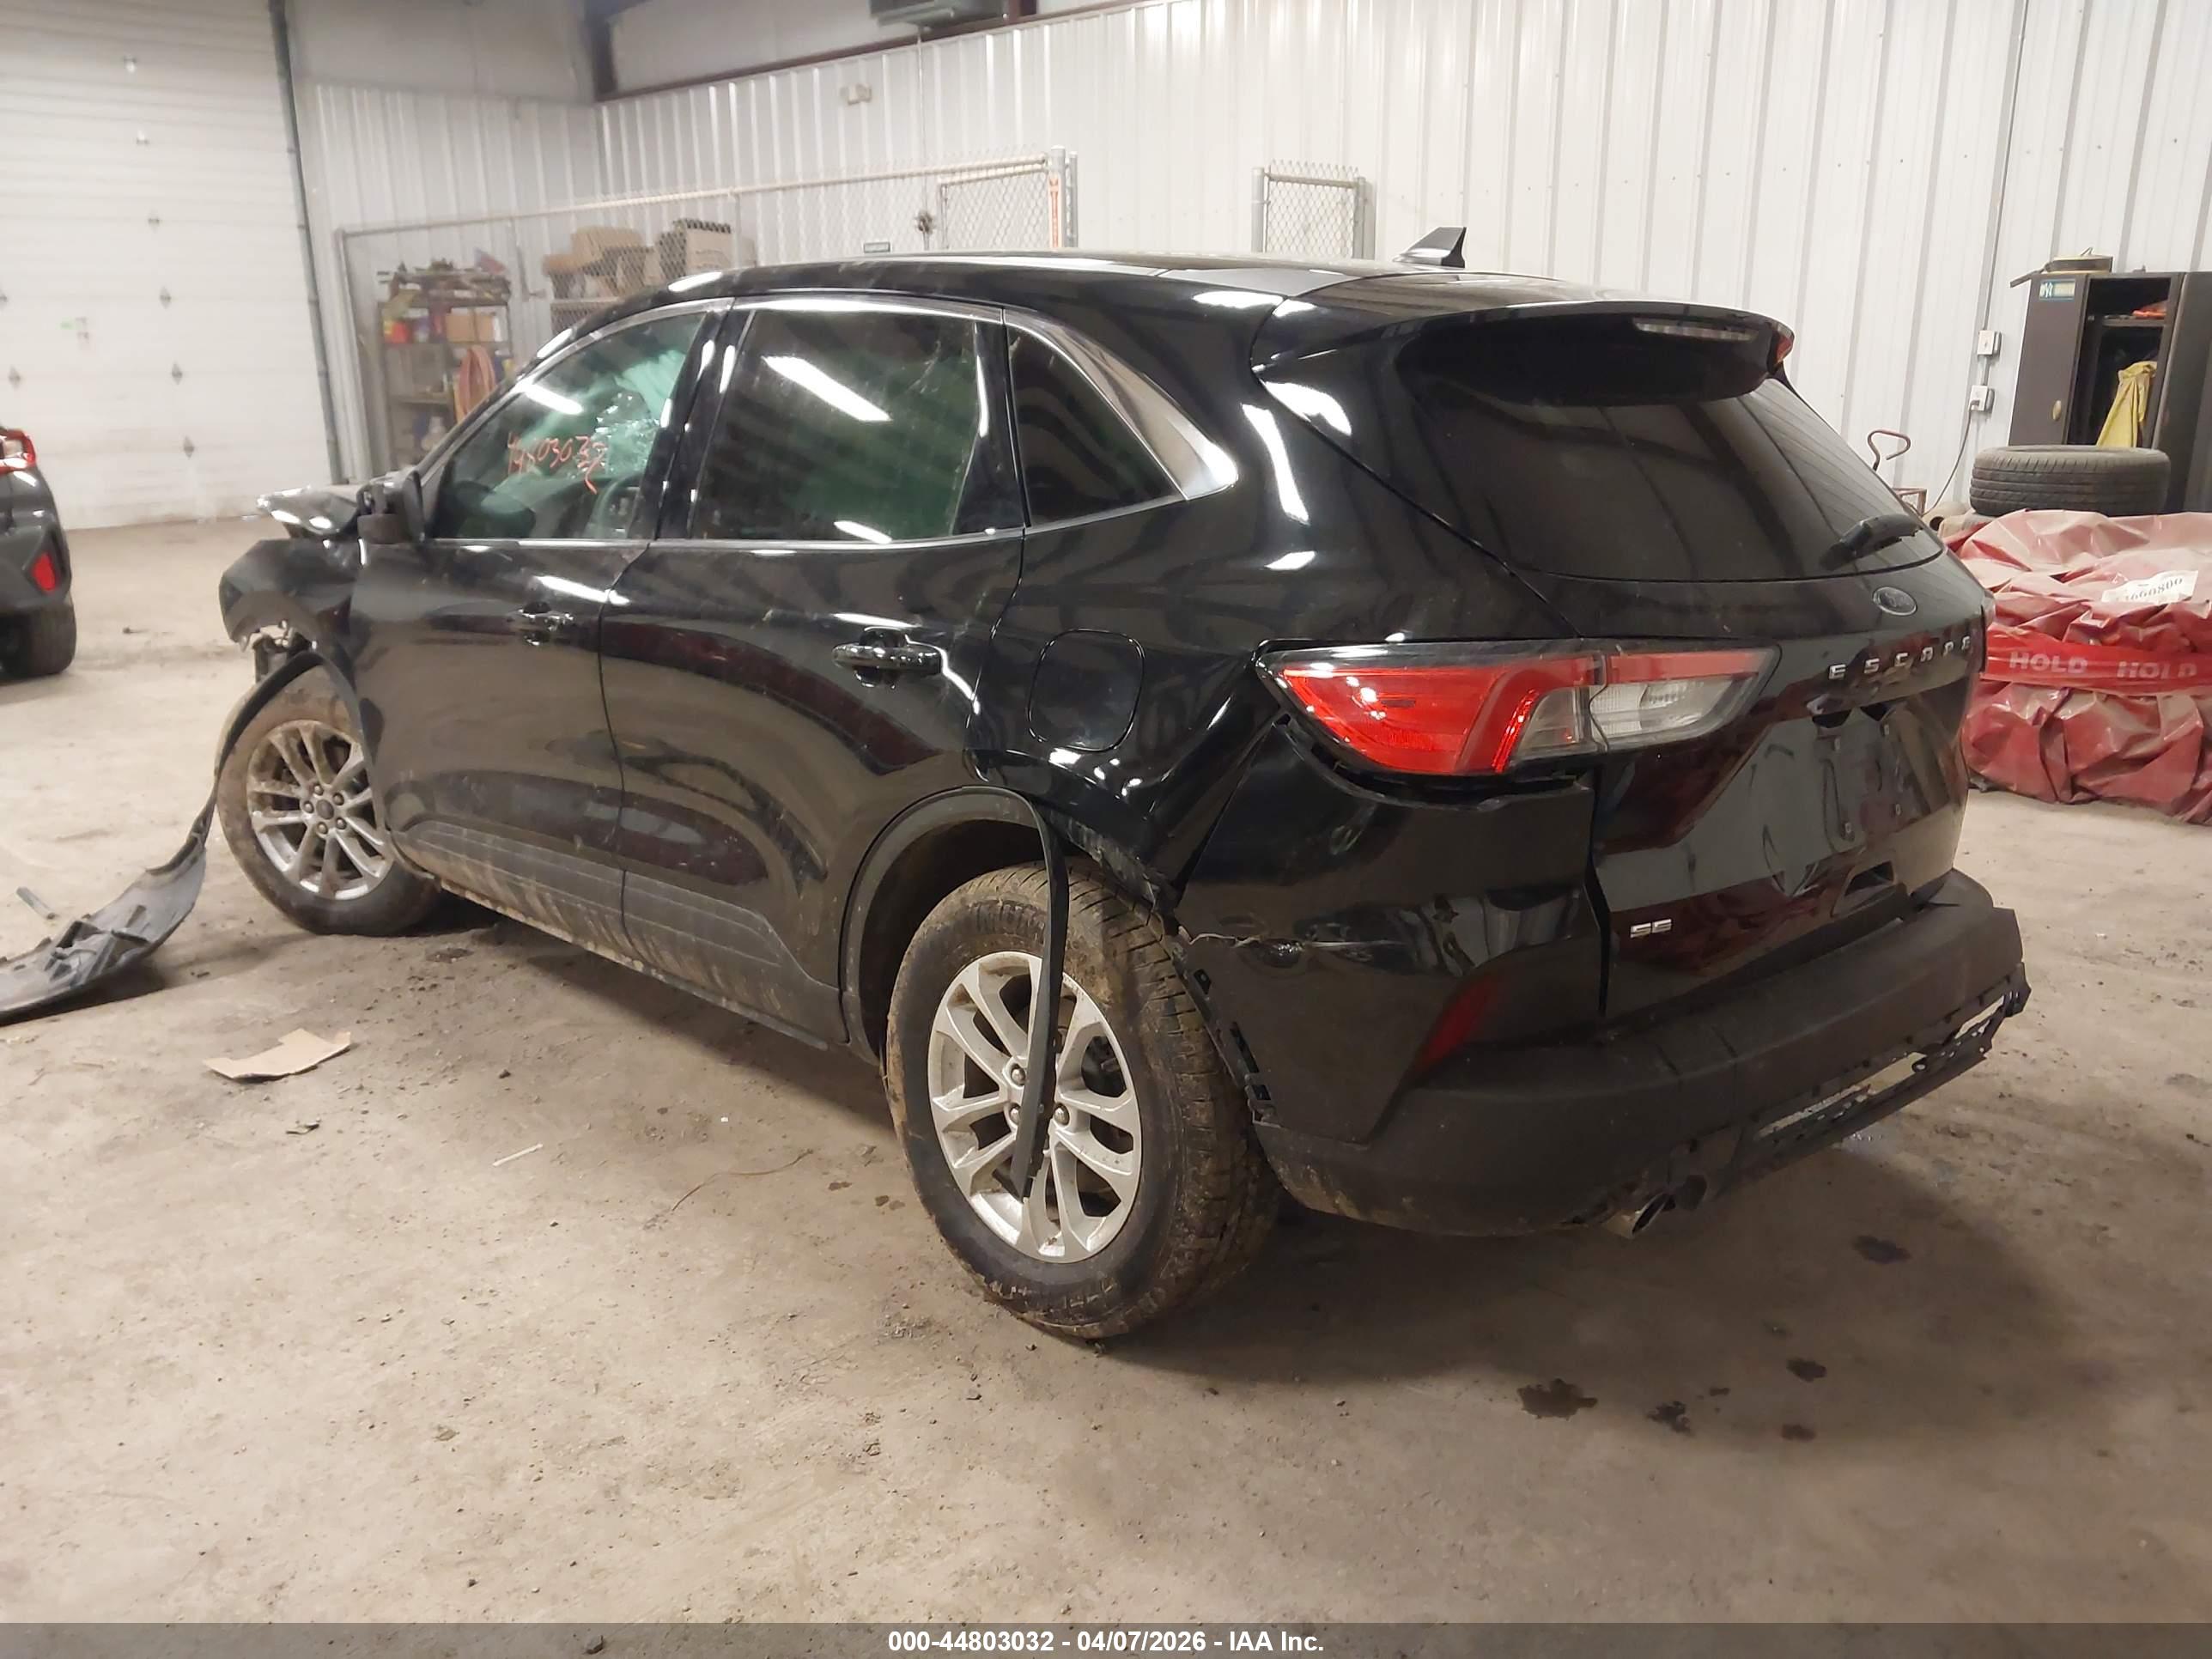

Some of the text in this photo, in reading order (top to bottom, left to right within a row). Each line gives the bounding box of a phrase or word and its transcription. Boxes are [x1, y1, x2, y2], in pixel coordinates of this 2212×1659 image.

[1828, 635, 1971, 680] ESCAPE
[2008, 651, 2088, 674] HOLD
[1631, 919, 1672, 939] SE
